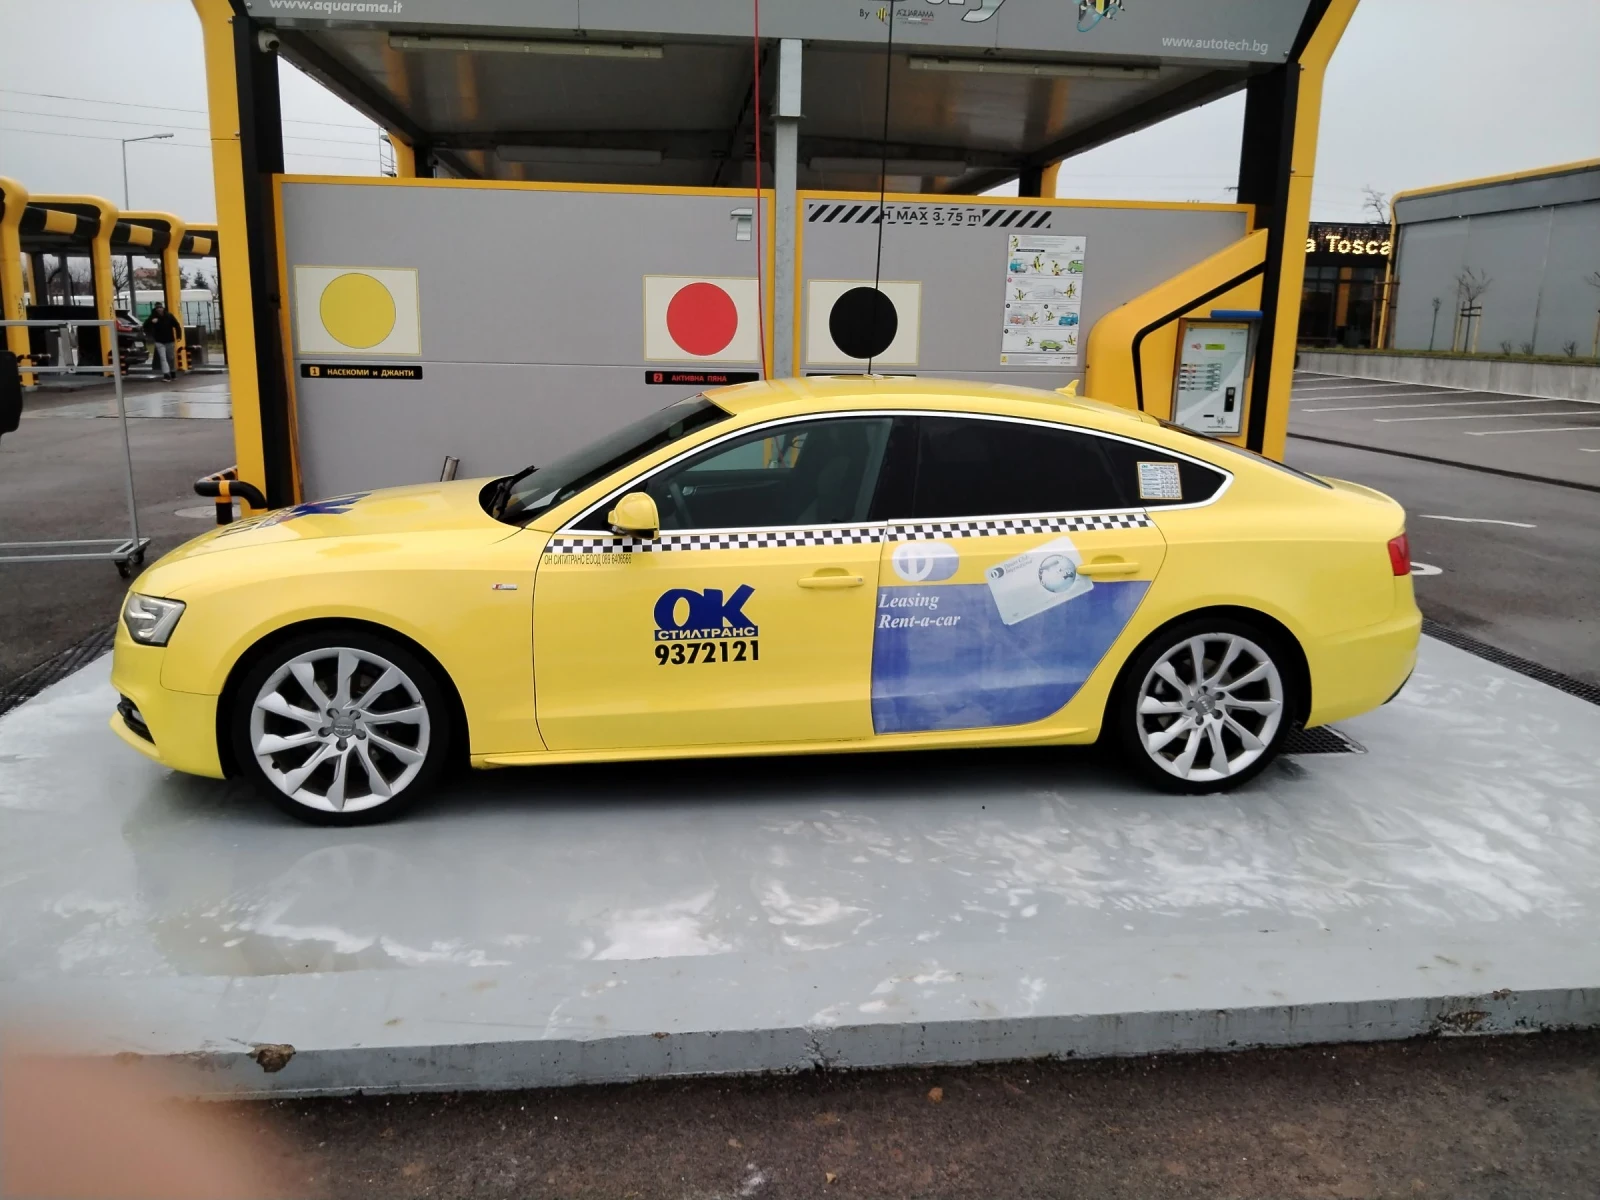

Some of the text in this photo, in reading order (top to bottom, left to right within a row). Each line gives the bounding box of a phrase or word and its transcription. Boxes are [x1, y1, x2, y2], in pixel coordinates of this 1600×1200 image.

[269, 0, 403, 14] www.aquarama.it
[859, 8, 870, 19] By
[1162, 37, 1268, 55] www.autotech.bg
[882, 210, 981, 222] H MAX 3.75 m
[1325, 235, 1392, 256] Tosca
[327, 368, 370, 376] НАСЕКОМИ
[381, 369, 414, 377] ДЖАНТИ
[671, 374, 704, 382] АКТИВНА
[554, 554, 585, 565] СИТИТРАНС
[586, 554, 601, 566] ЕООД
[878, 592, 940, 610] Leasing
[878, 614, 961, 629] Rent-a-car
[657, 626, 756, 640] СТИЛТРАНС
[654, 640, 759, 666] 9372121
